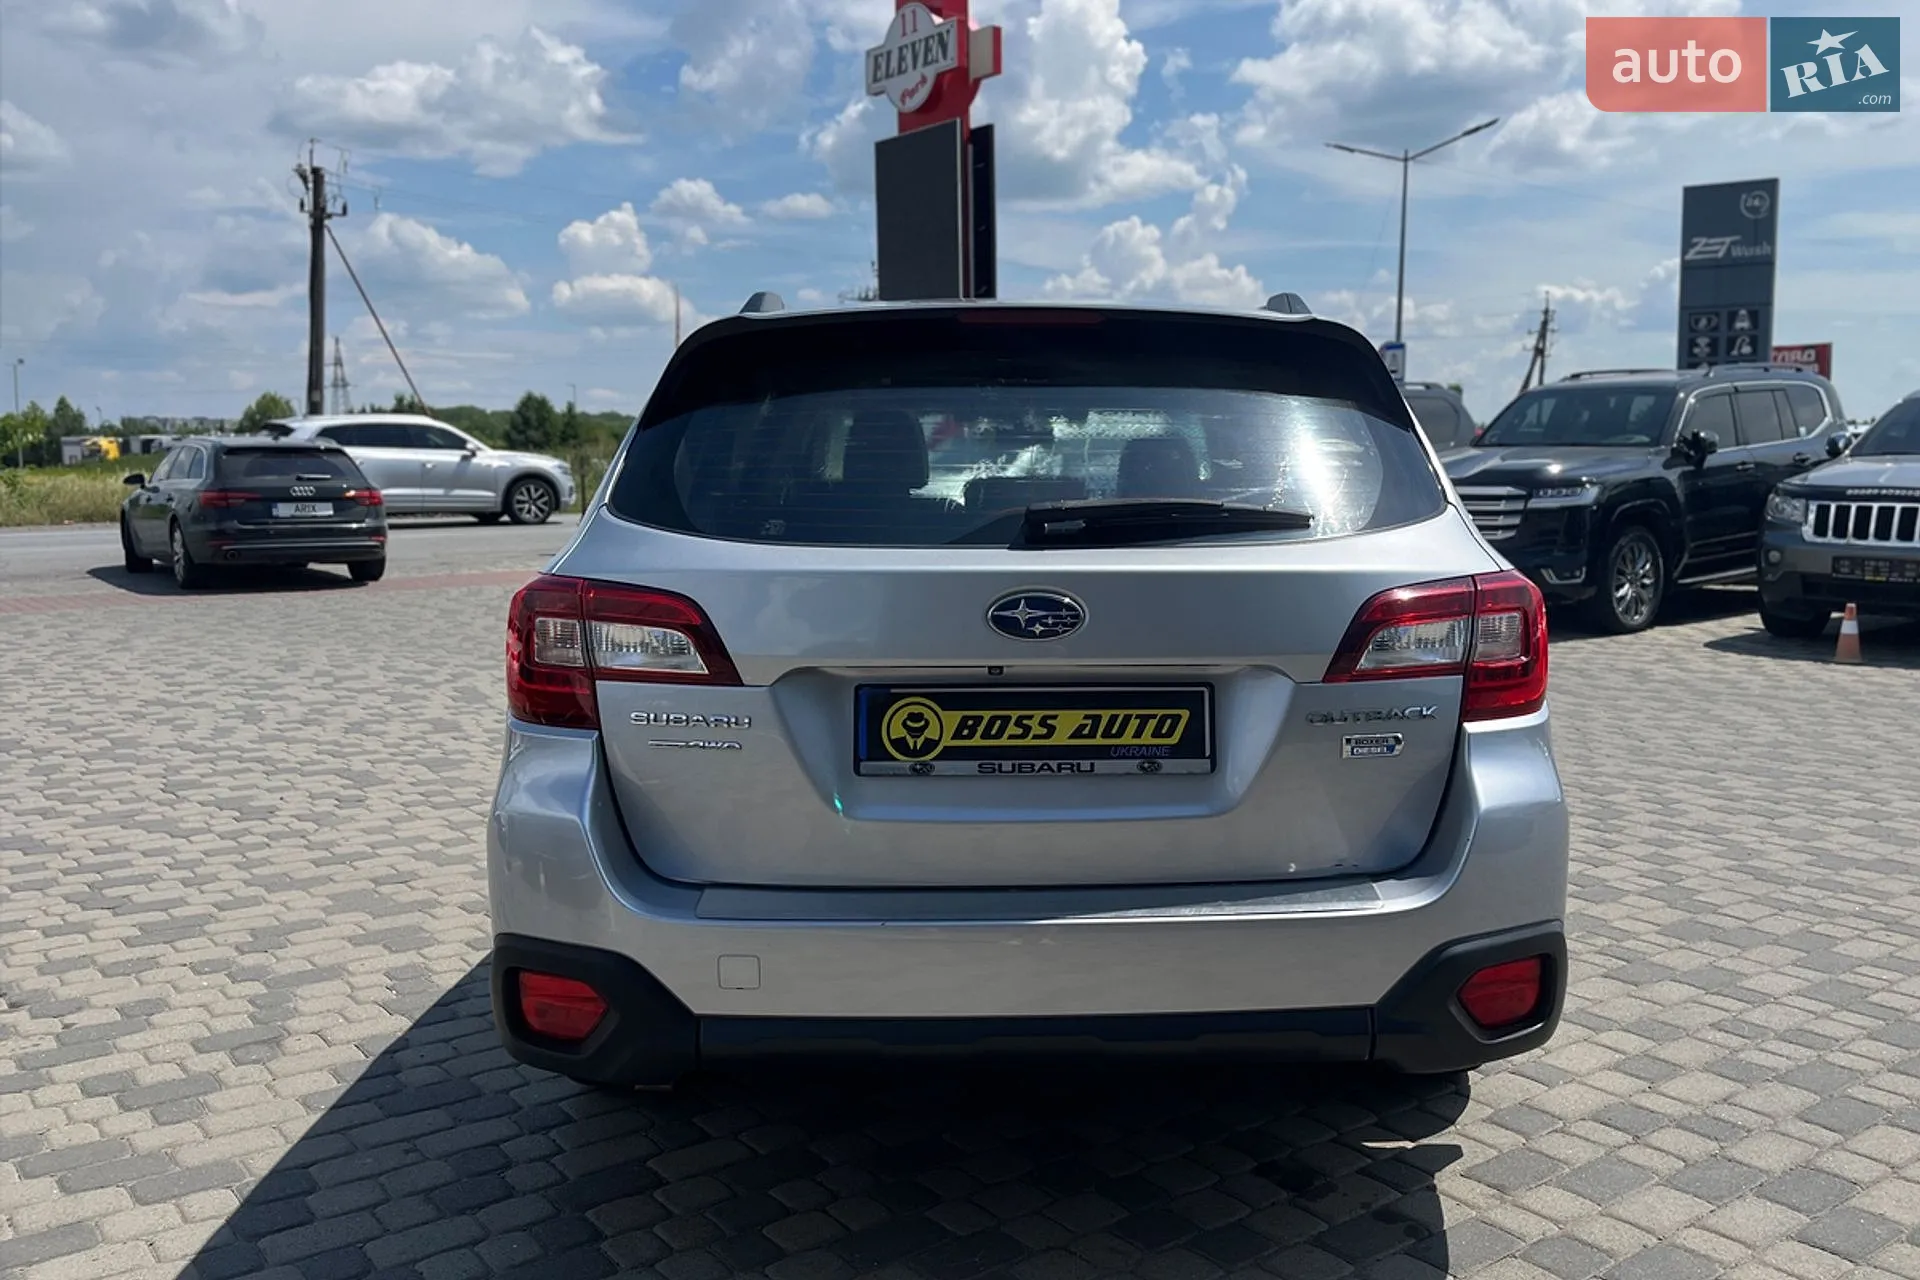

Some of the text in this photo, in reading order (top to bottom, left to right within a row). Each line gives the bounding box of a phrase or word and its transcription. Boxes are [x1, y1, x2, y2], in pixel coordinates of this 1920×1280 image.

[901, 8, 919, 38] 11
[872, 29, 951, 84] ELEVEN
[630, 710, 751, 729] SUBARU
[1305, 703, 1439, 726] OUTBACK
[949, 713, 1184, 741] BOSS AUTO
[1110, 745, 1172, 757] UKRAINE
[977, 762, 1095, 774] SUBARU
